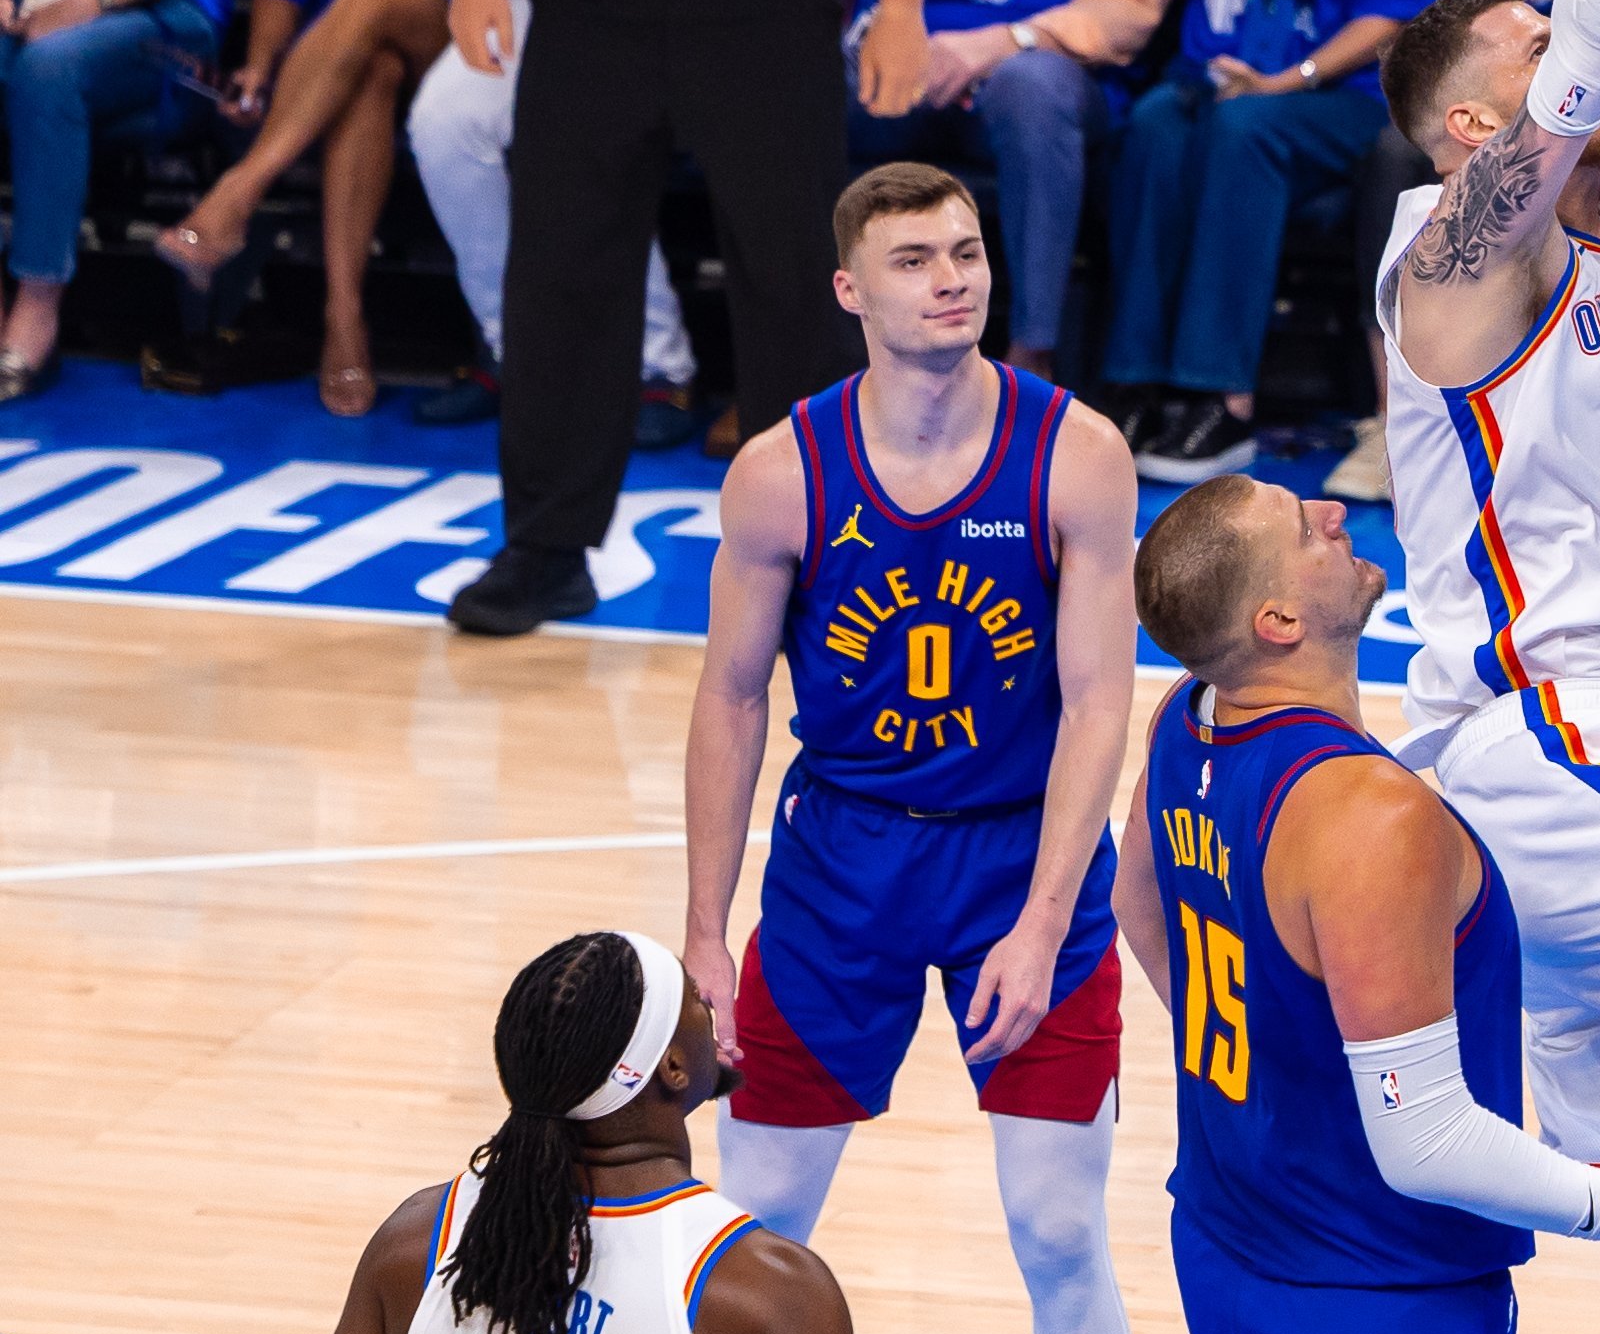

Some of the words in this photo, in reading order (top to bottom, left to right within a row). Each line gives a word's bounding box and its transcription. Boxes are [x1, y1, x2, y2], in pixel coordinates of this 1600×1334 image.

[0, 439, 722, 603] OFFS
[960, 518, 1026, 538] ibotta
[825, 566, 921, 663] MILE
[936, 558, 1037, 662] HIGH
[907, 622, 952, 701] 0
[872, 705, 980, 753] CITY
[1177, 896, 1252, 1105] 15
